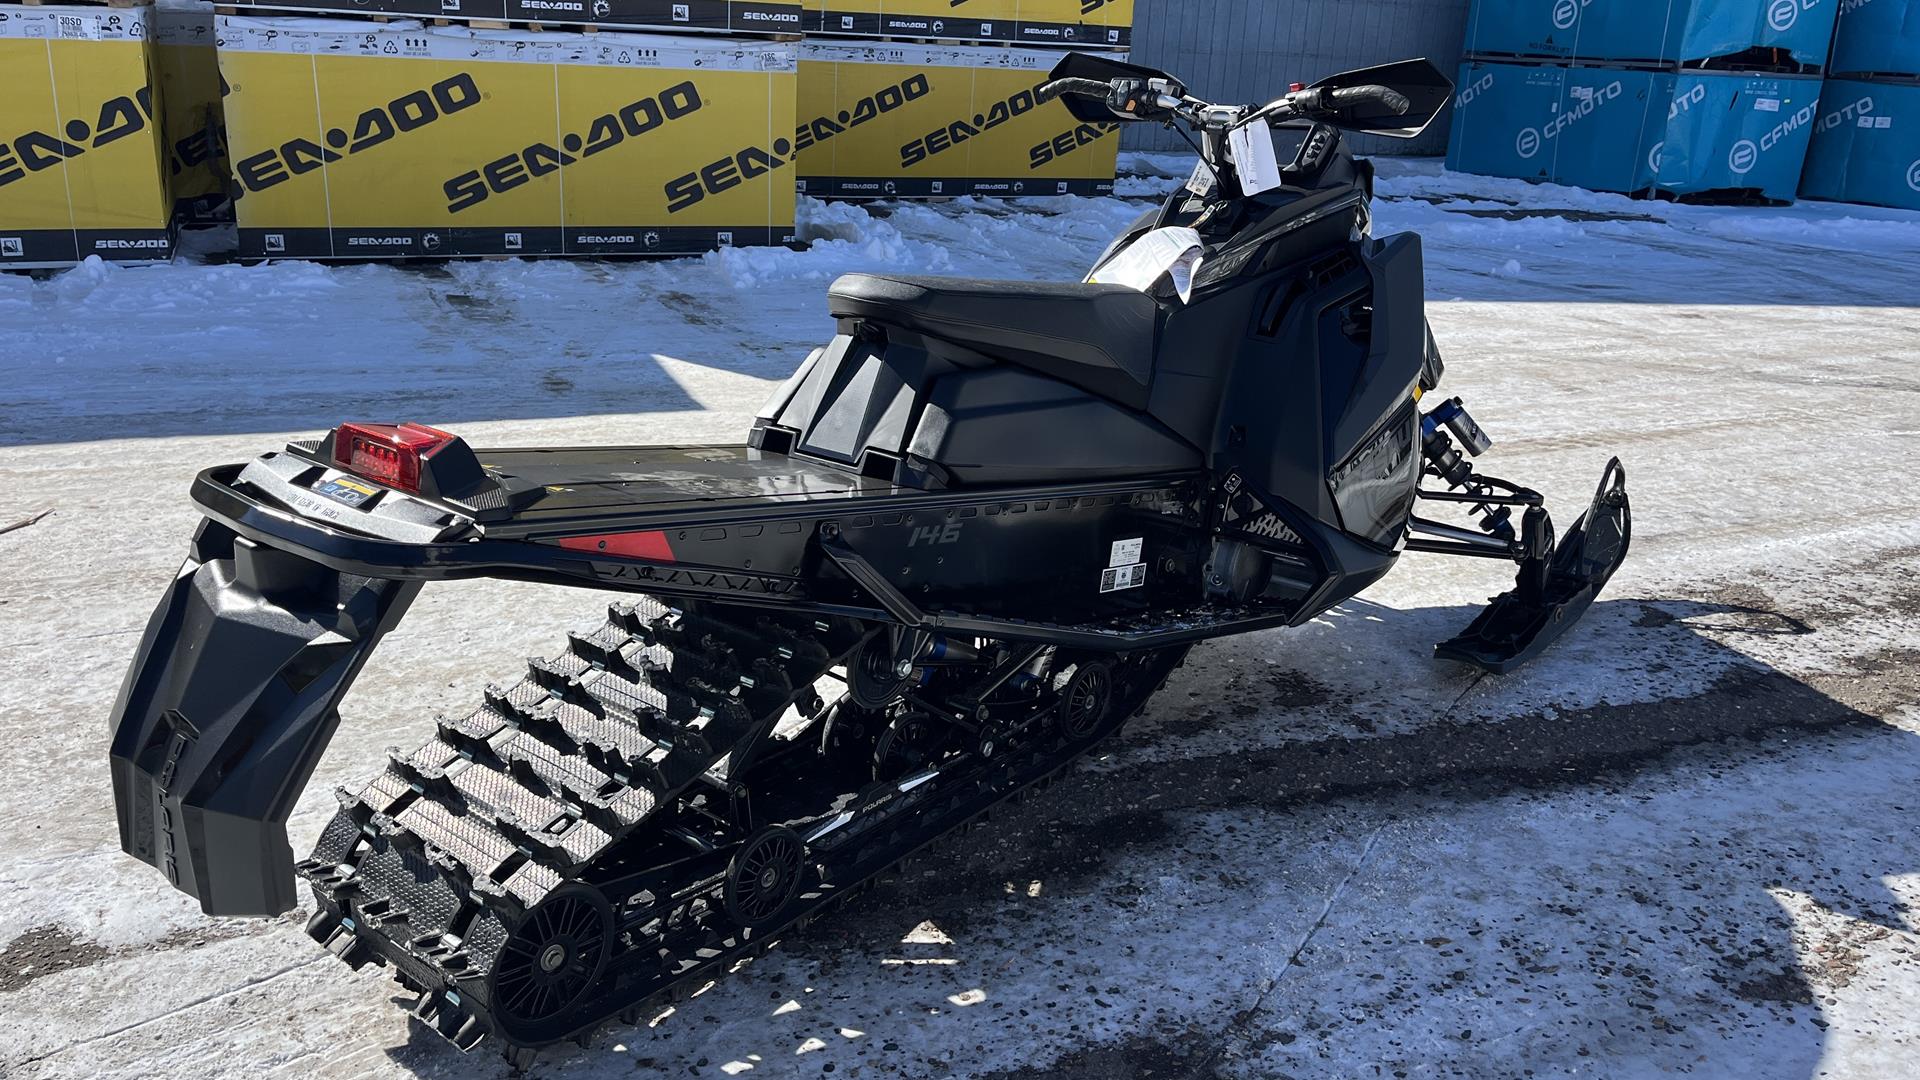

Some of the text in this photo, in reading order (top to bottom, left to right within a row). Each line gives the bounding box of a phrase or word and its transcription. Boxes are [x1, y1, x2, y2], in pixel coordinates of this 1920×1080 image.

[60, 16, 82, 26] 30SD
[1543, 80, 1622, 140] CFMOTO
[1760, 99, 1819, 152] CFMOT
[907, 522, 964, 547] 146
[862, 793, 892, 814] POLARIS
